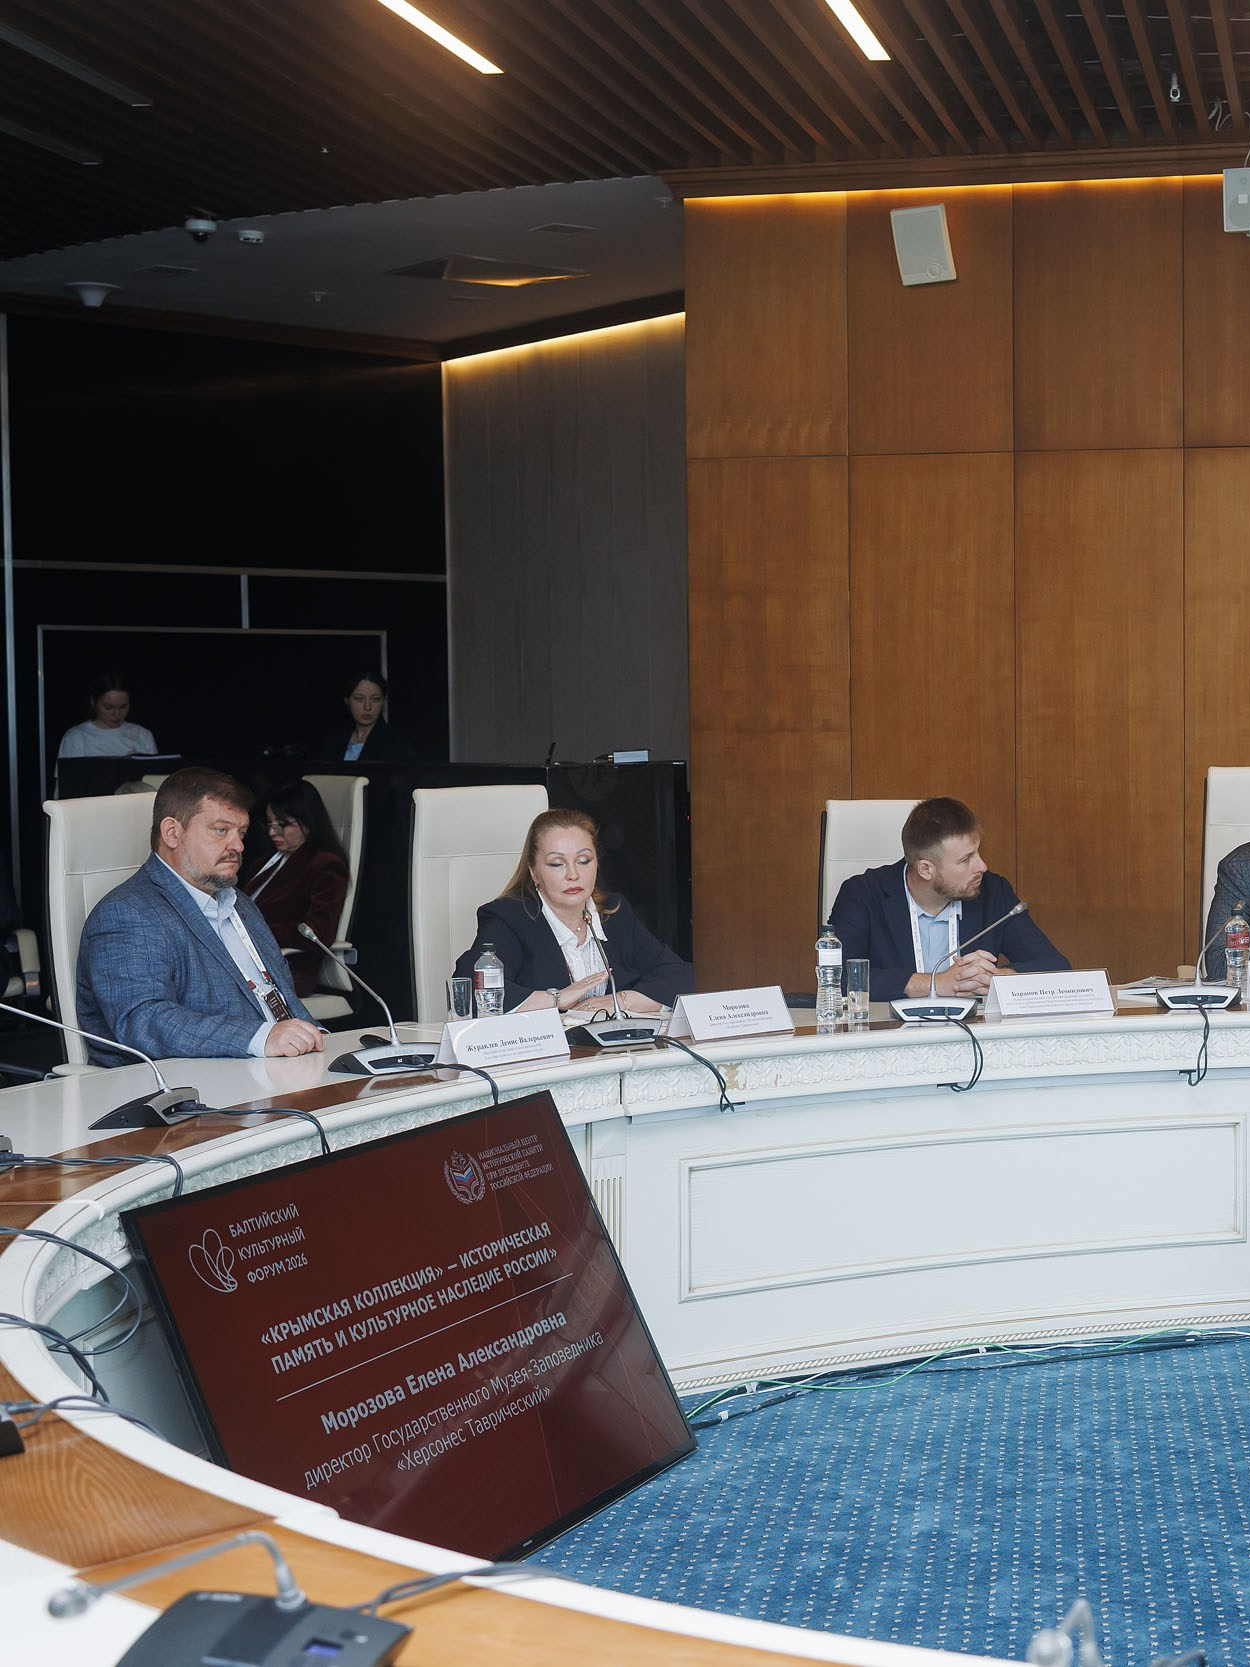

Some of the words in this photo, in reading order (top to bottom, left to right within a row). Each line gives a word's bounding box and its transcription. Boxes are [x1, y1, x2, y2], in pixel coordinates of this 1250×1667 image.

[708, 1014, 726, 1022] Елена
[465, 1042, 499, 1054] Журавлев
[500, 1038, 518, 1048] Денис
[518, 1033, 554, 1044] Валерьевич
[481, 1150, 522, 1170] ИСТОРИЧЕСКОЙ
[522, 1144, 544, 1157] ПАМЯТИ
[486, 1170, 498, 1180] ПРИ
[498, 1160, 531, 1176] ПРЕЗИДЕНТЕ
[490, 1171, 525, 1190] РОССИЙСКОЙ
[523, 1162, 554, 1180] ФЕДЕРАЦИИ
[228, 1202, 300, 1238] БАЛТИЙСКИЙ
[238, 1226, 306, 1260] КУЛЬТУРНЫЙ
[247, 1260, 286, 1284] ФОРУМ
[286, 1253, 308, 1271] 2026
[261, 1298, 352, 1344] «КРЫМСКАЯ
[352, 1266, 443, 1311] КОЛЛЕКЦИЯ»
[458, 1221, 552, 1269] ИСТОРИЧЕСКАЯ
[270, 1337, 334, 1374] ПАМЯТЬ
[334, 1330, 348, 1348] И
[348, 1294, 438, 1342] КУЛЬТУРНОЕ
[436, 1266, 504, 1306] НАСЛЕДИЕ
[503, 1248, 558, 1279] РОССИИ»
[320, 1384, 406, 1435] Морозова
[406, 1362, 456, 1396] Елена
[457, 1311, 568, 1373] Александровна
[304, 1442, 372, 1491] директор
[372, 1386, 490, 1454] Государственного
[490, 1331, 604, 1396] Музея-Заповедника
[397, 1428, 467, 1471] «Херсонес
[464, 1384, 551, 1438] Таврический»
